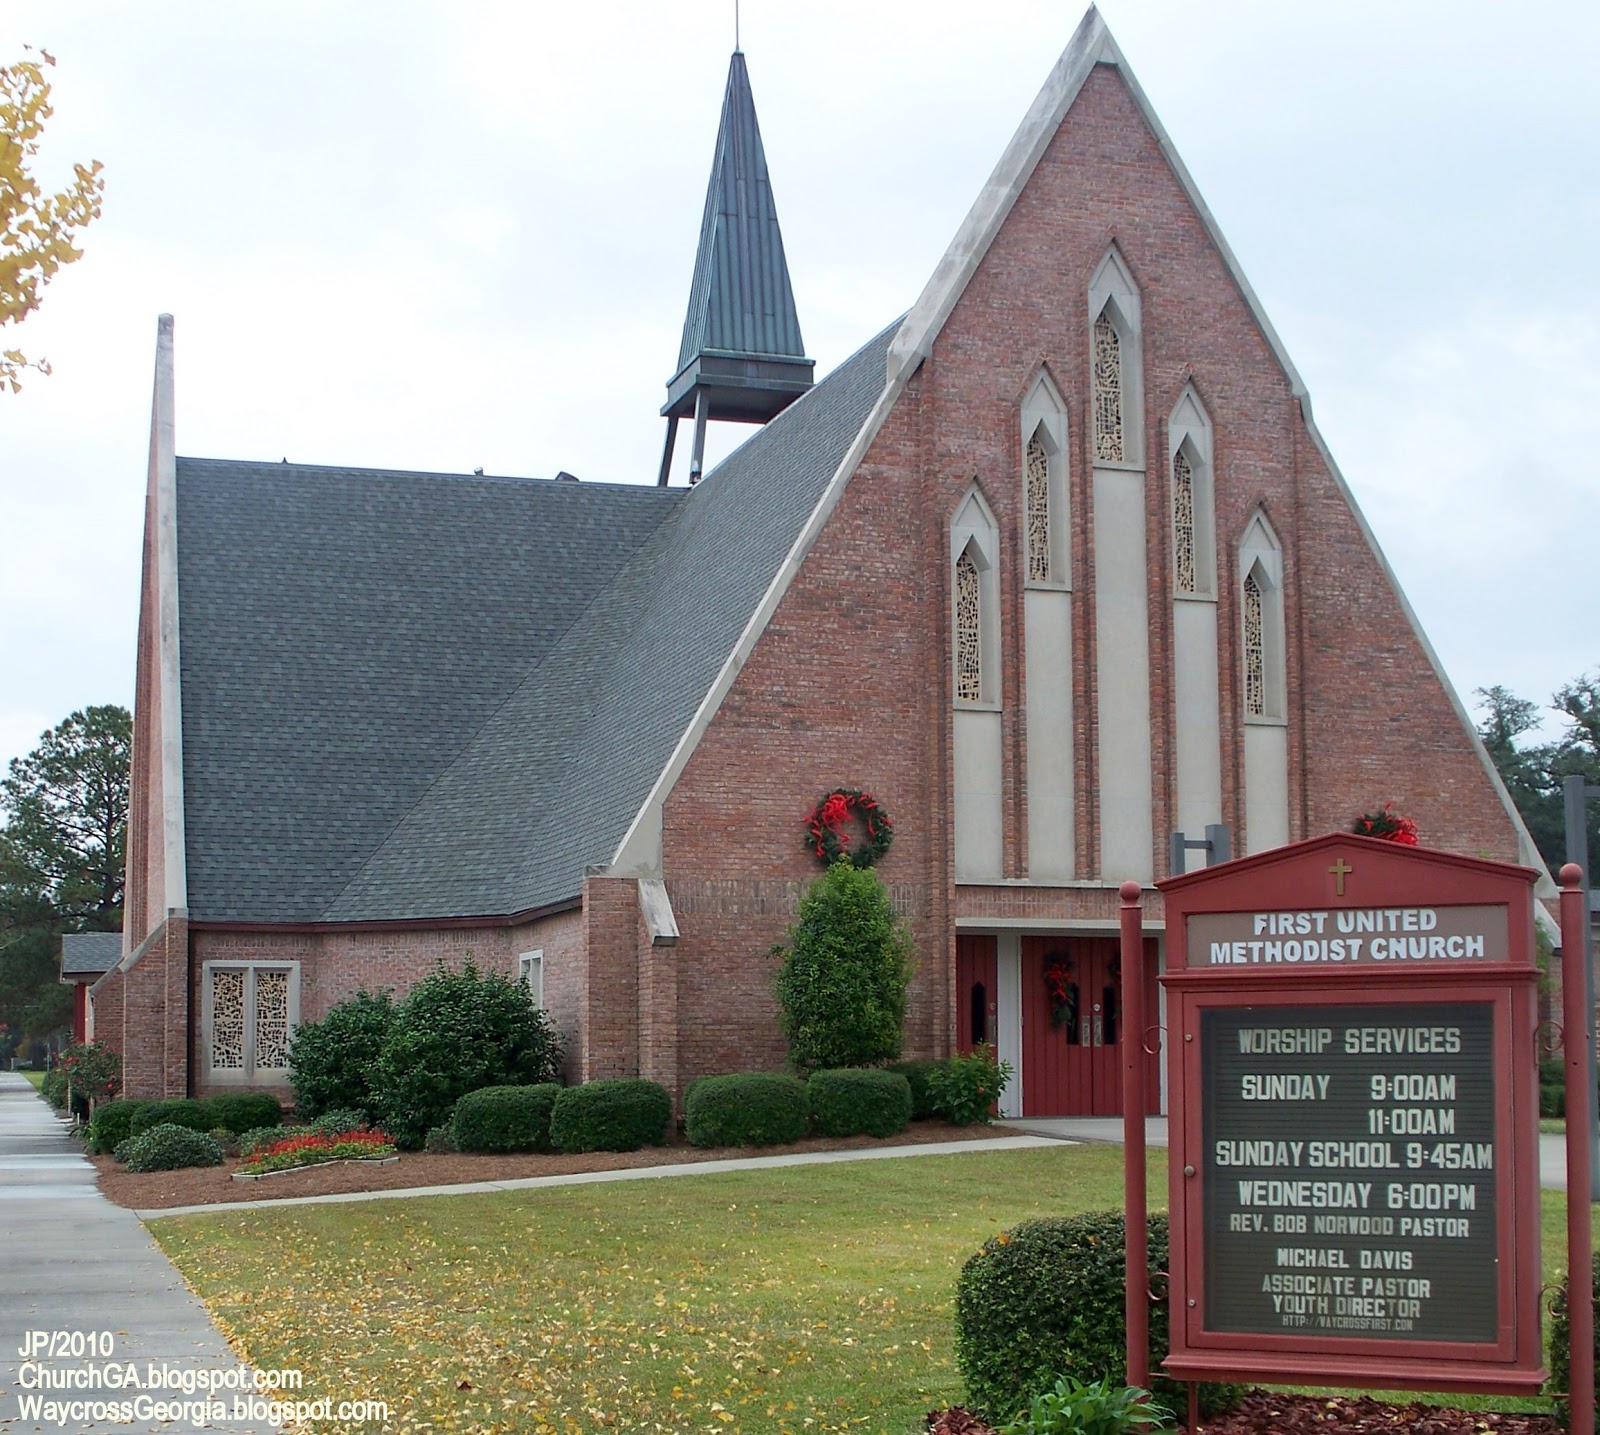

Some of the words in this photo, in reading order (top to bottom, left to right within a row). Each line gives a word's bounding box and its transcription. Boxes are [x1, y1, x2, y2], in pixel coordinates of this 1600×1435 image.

[1254, 912, 1328, 935] FIRST
[1337, 909, 1437, 933] UNITED
[1211, 939, 1363, 964] METHODIST
[1239, 1028, 1332, 1054] WORSHIP
[1345, 1027, 1461, 1054] SERVICES
[1242, 1075, 1330, 1100] SUNDAY
[1371, 1075, 1456, 1100] 9:00AM
[1368, 1109, 1455, 1135] 11:00AM
[1216, 1141, 1303, 1168] SUNDAY
[1309, 1142, 1400, 1168] SCHOOL
[1406, 1143, 1493, 1169] 9:45AM
[1239, 1181, 1372, 1208] WEDNESDAY
[1387, 1183, 1476, 1210] 6:00PM
[1230, 1214, 1269, 1232] REV.
[1274, 1215, 1306, 1233] BOB
[1314, 1216, 1393, 1236] NORWOOD
[1401, 1218, 1469, 1237] PASTOR
[1277, 1249, 1349, 1269] MICHAEL
[1360, 1250, 1413, 1270] DAVIS
[1262, 1274, 1354, 1296] ASSOCIATE
[1362, 1277, 1430, 1298] PASTOR
[1272, 1295, 1328, 1316] YOUTH
[1336, 1297, 1420, 1318] DIRECTOR
